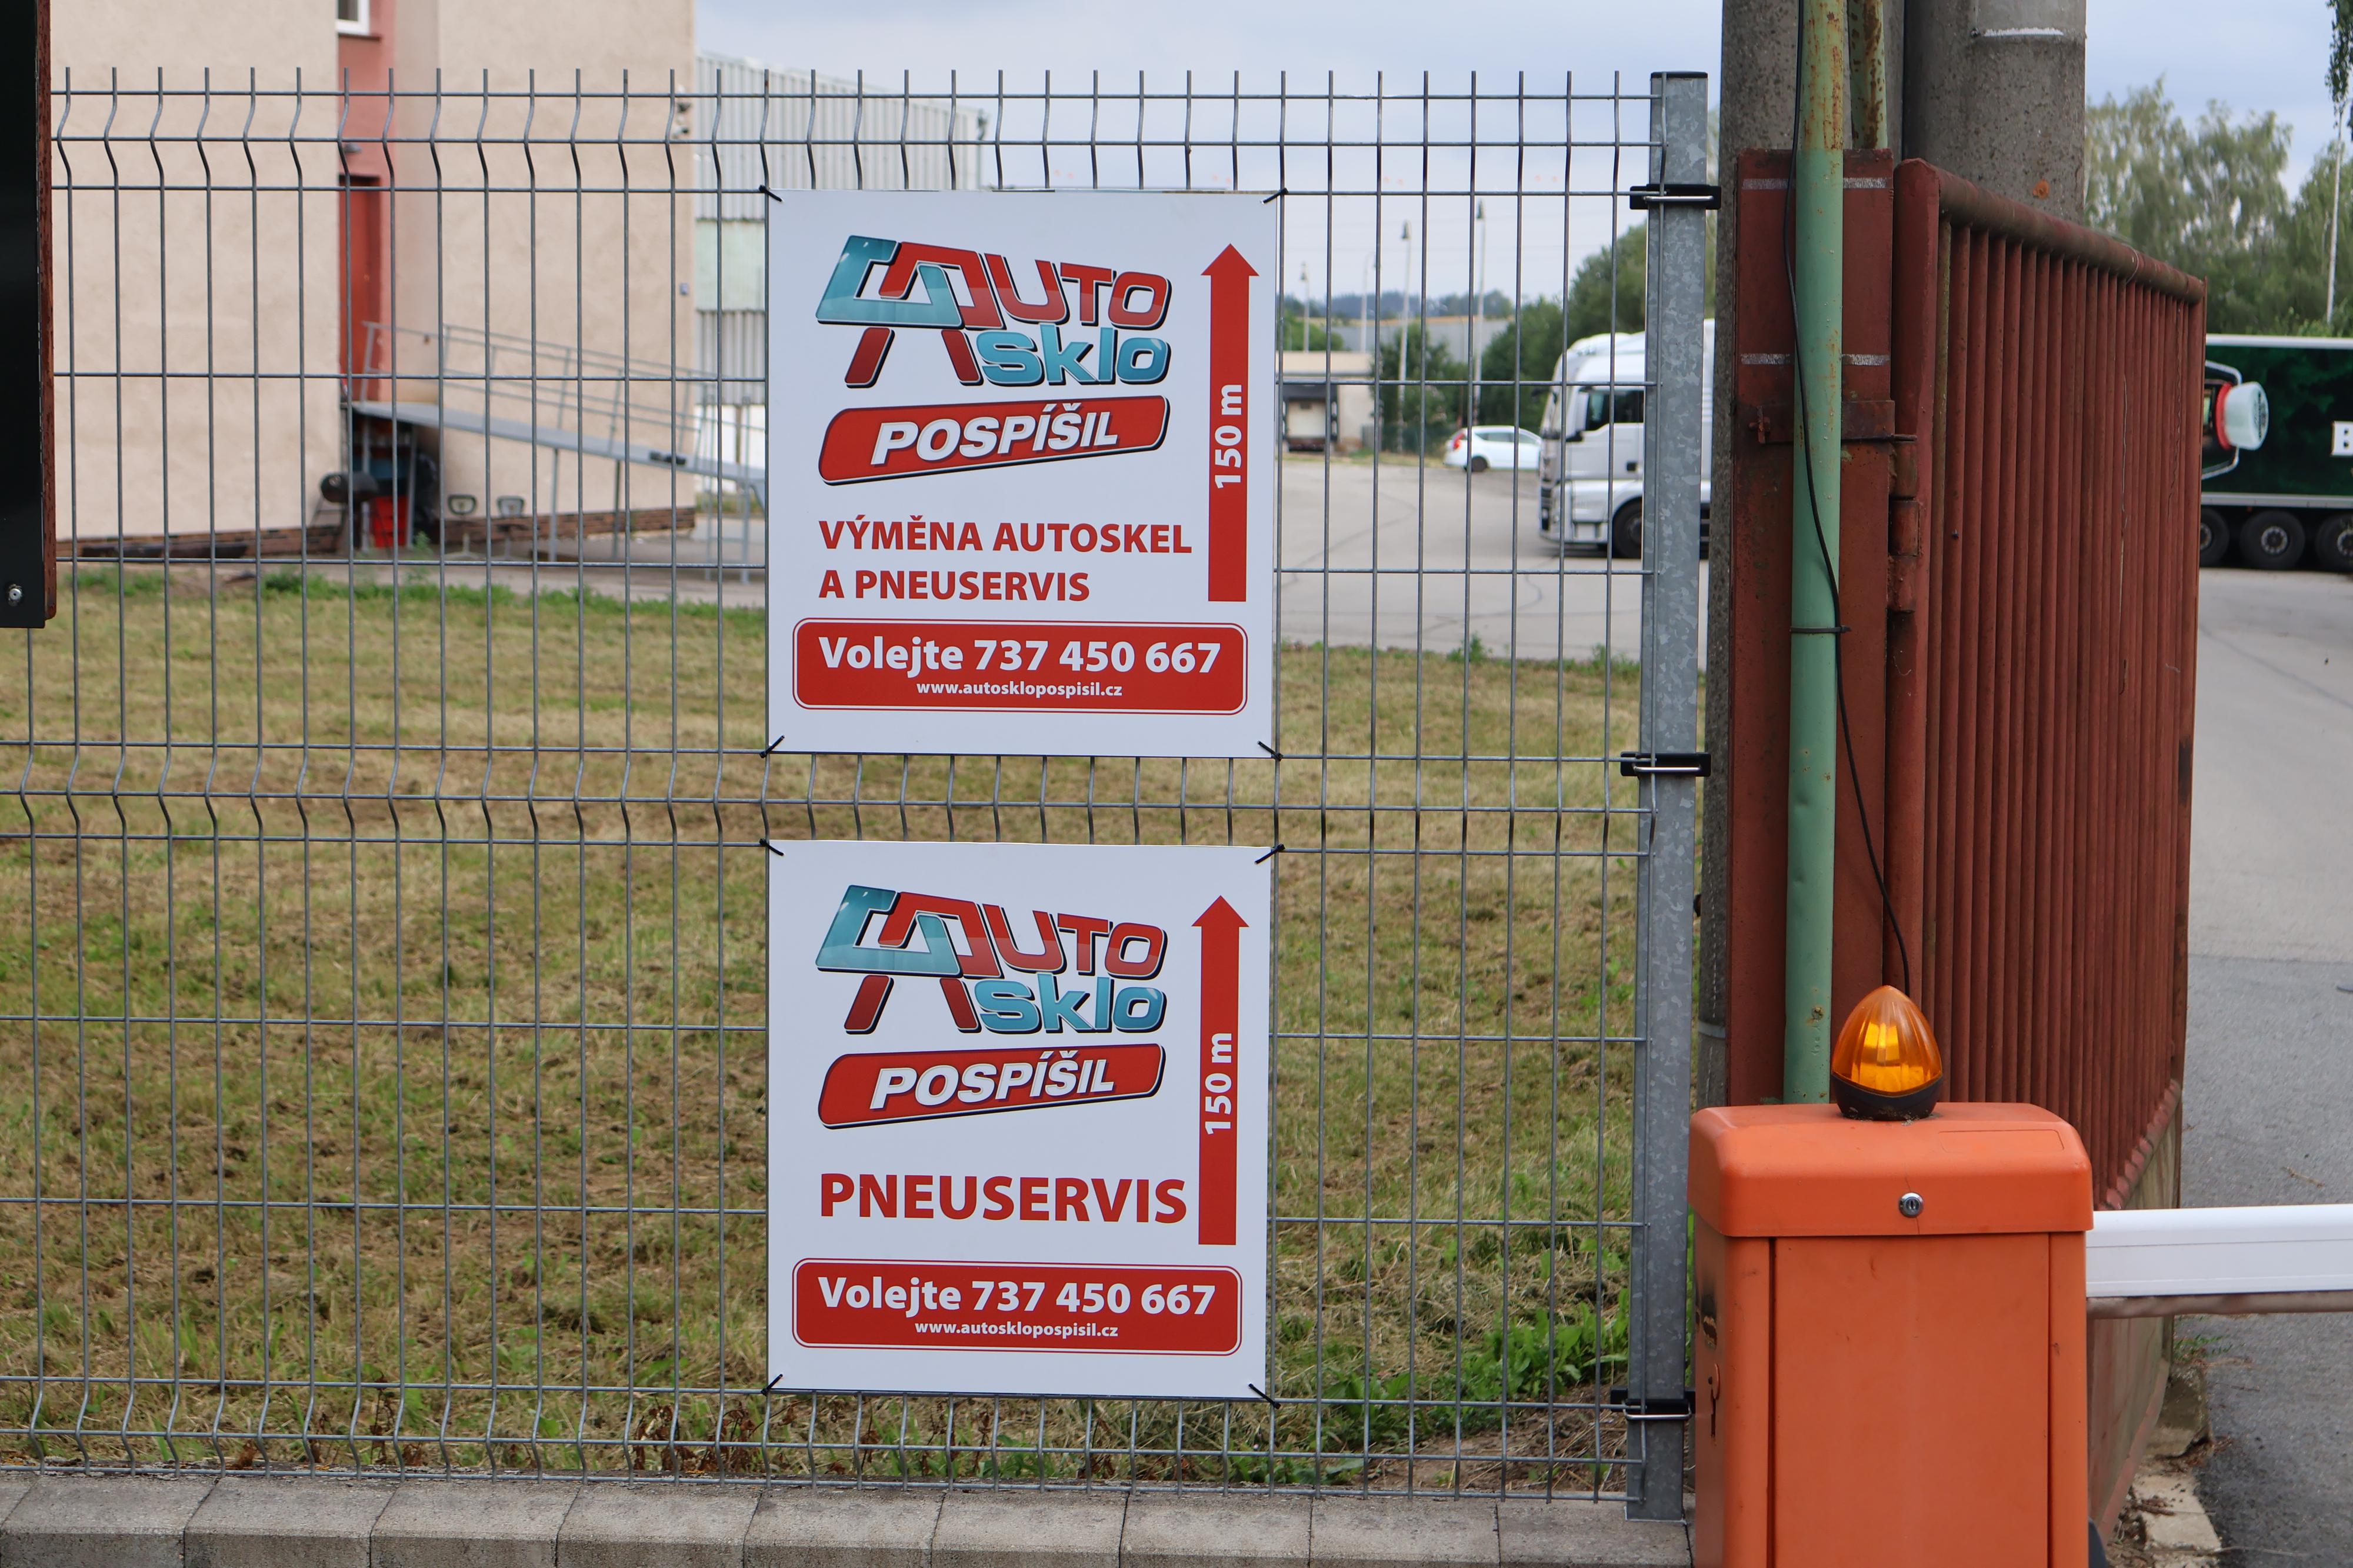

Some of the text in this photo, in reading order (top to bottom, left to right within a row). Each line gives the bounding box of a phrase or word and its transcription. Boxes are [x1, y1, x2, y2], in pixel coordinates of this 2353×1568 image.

[815, 235, 1171, 388] AUTO
[871, 402, 1119, 465] POSPÍŠIL
[1215, 384, 1242, 489] 150 m
[818, 515, 1192, 554] VÝMĚNA AUTOSKEL
[818, 569, 1090, 602] A PNEUSERVIS
[818, 636, 1221, 679] Volejte 737 450 667
[916, 680, 1123, 699] www.autosklopospisil.cz
[815, 885, 1168, 1035] AUTO
[869, 1050, 1115, 1110] POSPÍŠIL
[1205, 1033, 1232, 1135] 150 m
[821, 1173, 1187, 1225] PNEUSERVIS
[817, 1276, 1216, 1319] Volejte 737 450 667
[914, 1320, 1119, 1339] www.autosklopospisil.cz
